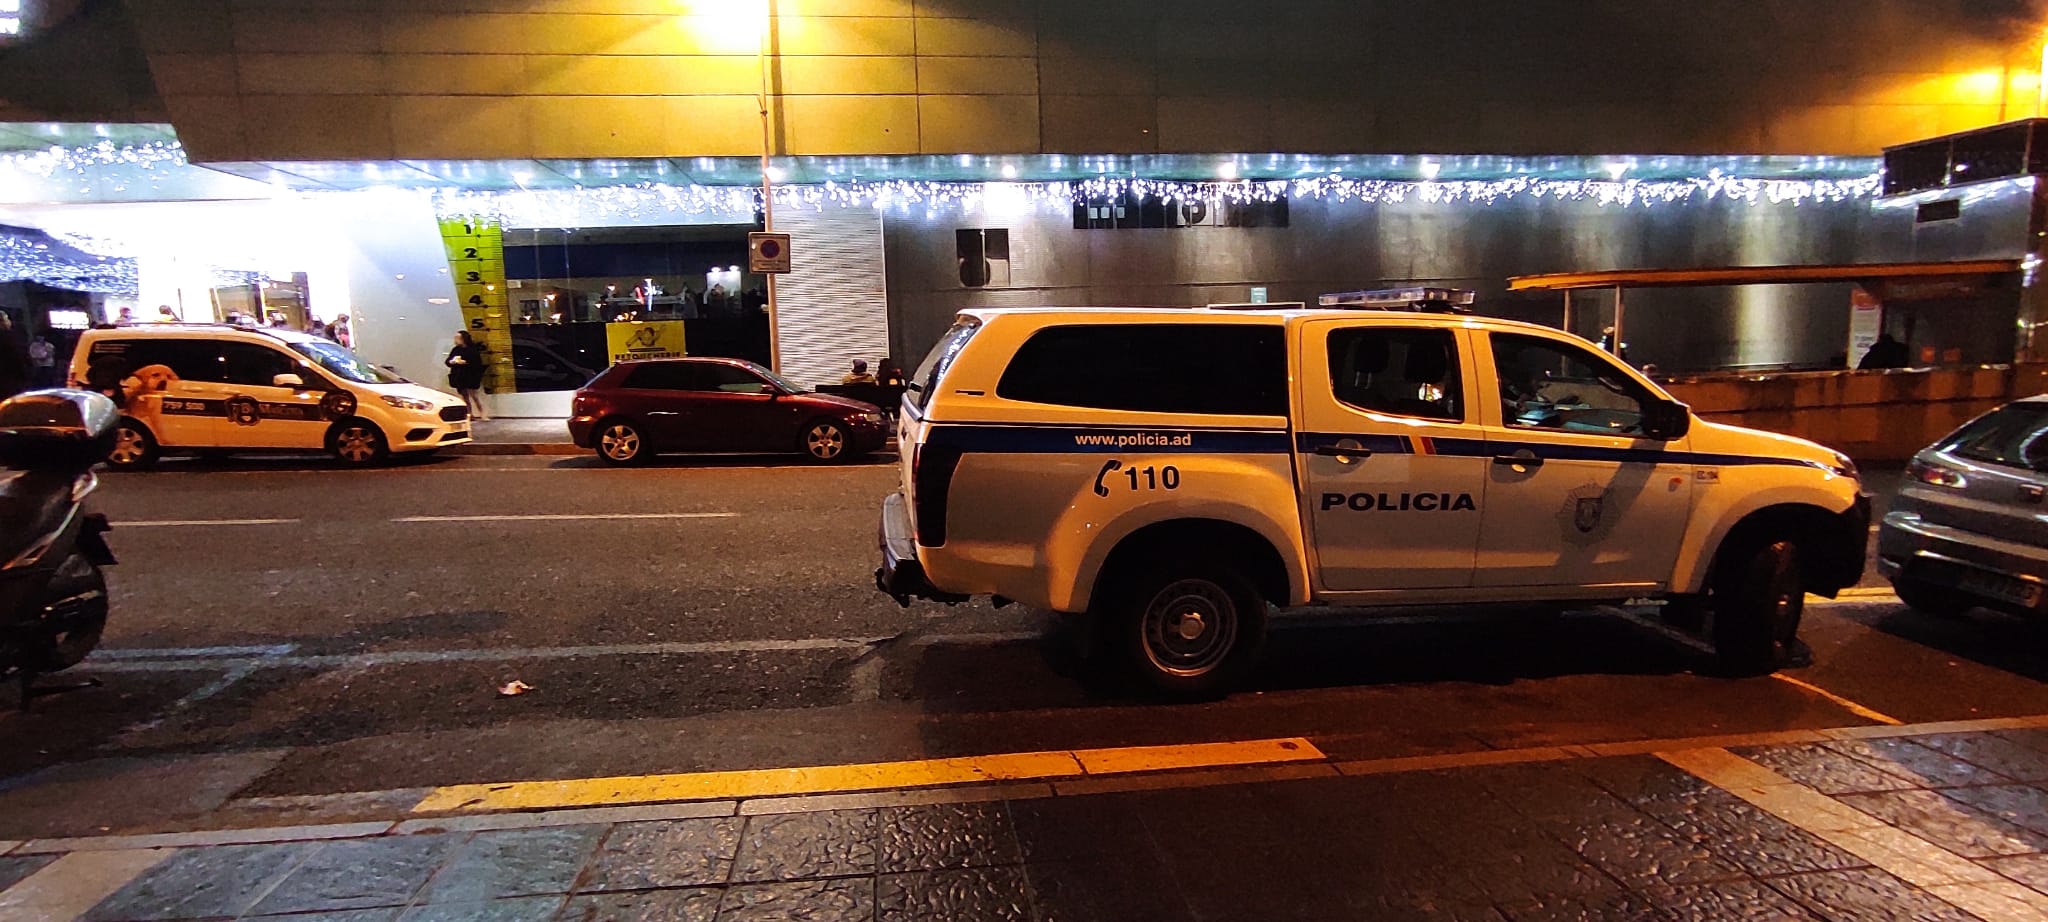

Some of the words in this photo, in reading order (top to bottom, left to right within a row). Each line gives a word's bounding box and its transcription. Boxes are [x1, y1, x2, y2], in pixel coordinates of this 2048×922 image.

[463, 224, 471, 234] 1
[463, 247, 478, 259] 2
[466, 271, 480, 282] 3
[468, 294, 483, 306] 4
[471, 318, 485, 329] 5
[1074, 432, 1192, 447] www.policia.ad
[1124, 465, 1180, 491] 110
[1320, 492, 1476, 511] POLICIA
